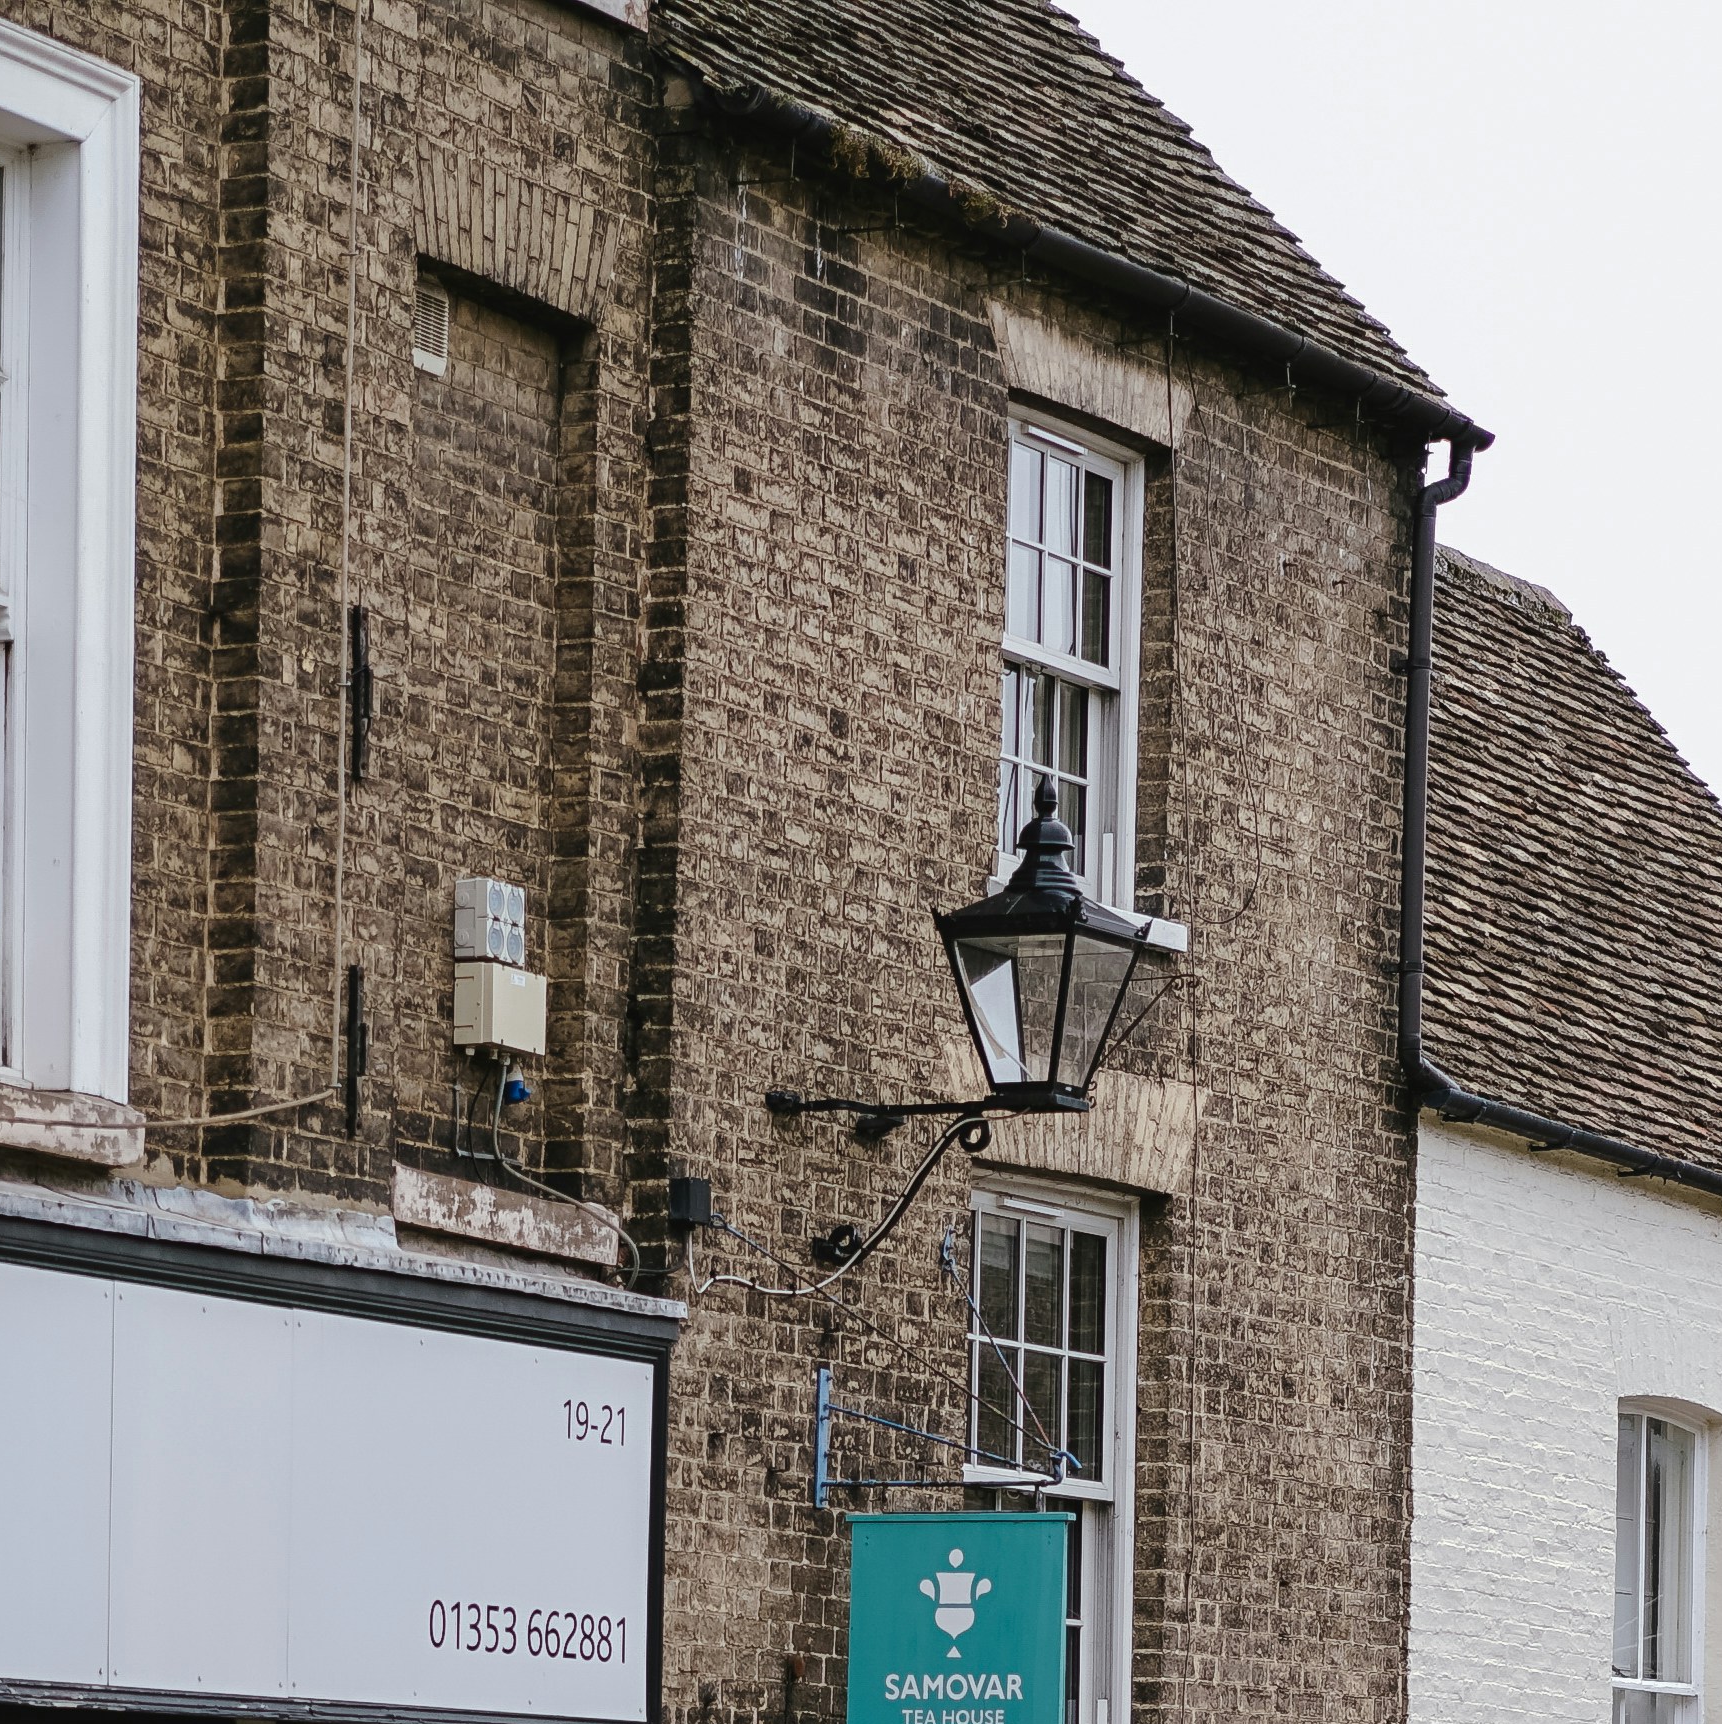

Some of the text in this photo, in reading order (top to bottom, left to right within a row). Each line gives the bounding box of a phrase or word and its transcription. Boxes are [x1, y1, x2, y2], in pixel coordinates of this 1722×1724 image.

[563, 1399, 626, 1446] 19-21
[429, 1599, 627, 1664] 01353 662881
[885, 1674, 1023, 1700] SAMOVAR
